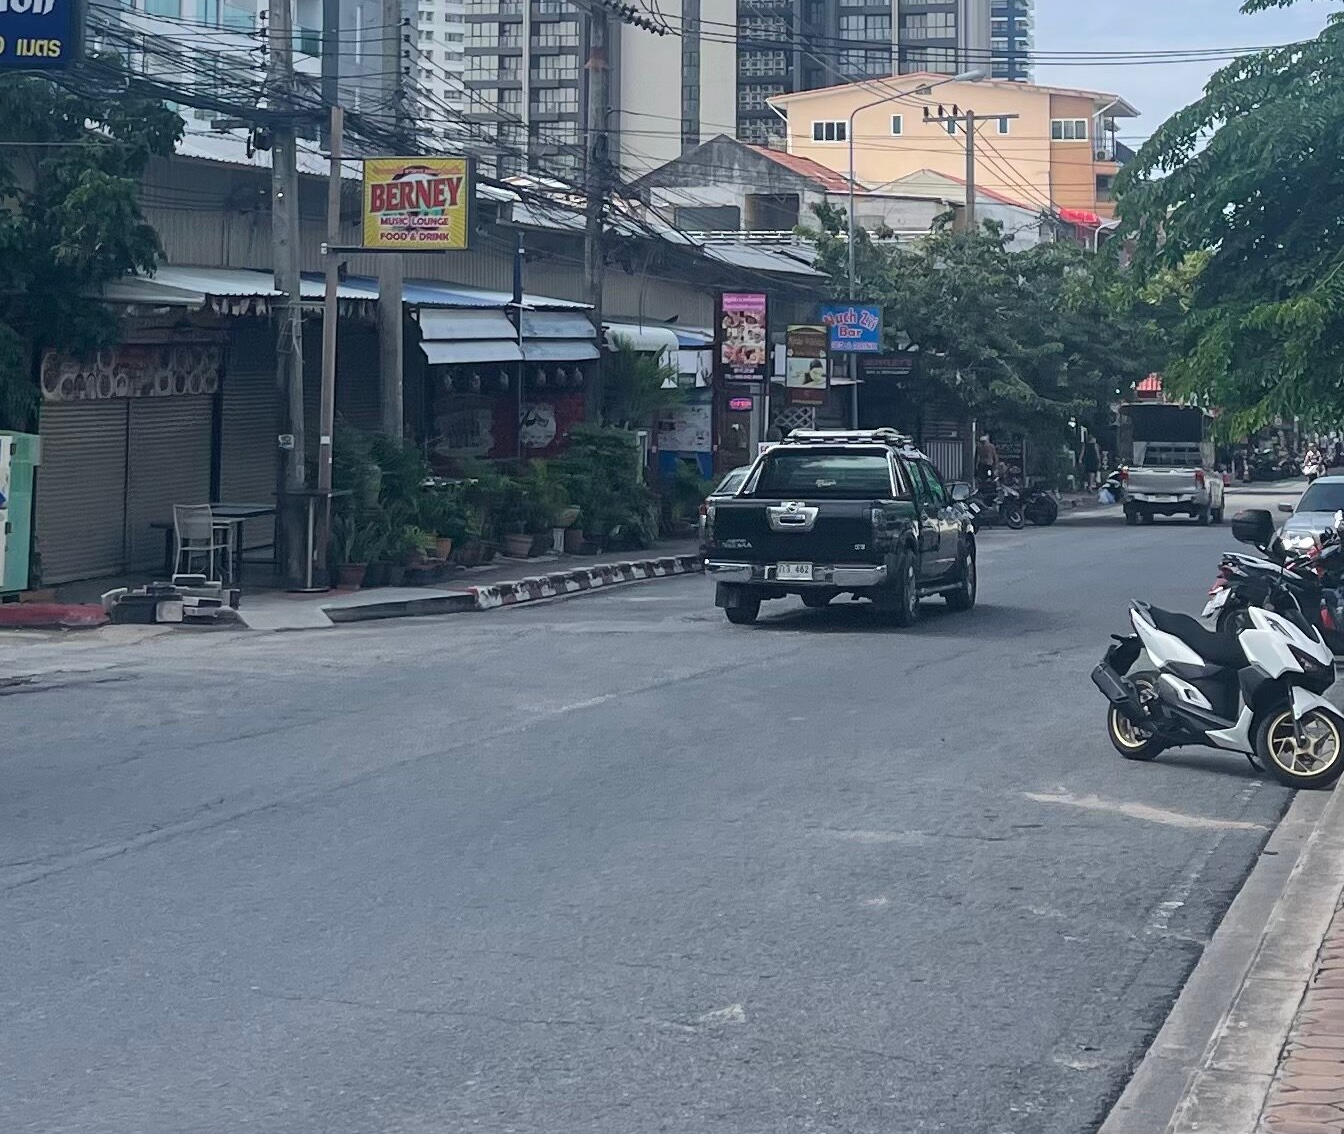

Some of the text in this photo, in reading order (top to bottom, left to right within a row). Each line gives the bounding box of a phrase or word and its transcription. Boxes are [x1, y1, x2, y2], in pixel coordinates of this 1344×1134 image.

[16, 38, 61, 57] เมตร
[369, 176, 463, 213] BERNEY
[380, 217, 449, 226] MUSIC LOUNGE
[380, 232, 407, 241] FOOD
[419, 232, 450, 241] DRINK
[838, 326, 863, 338] Bar
